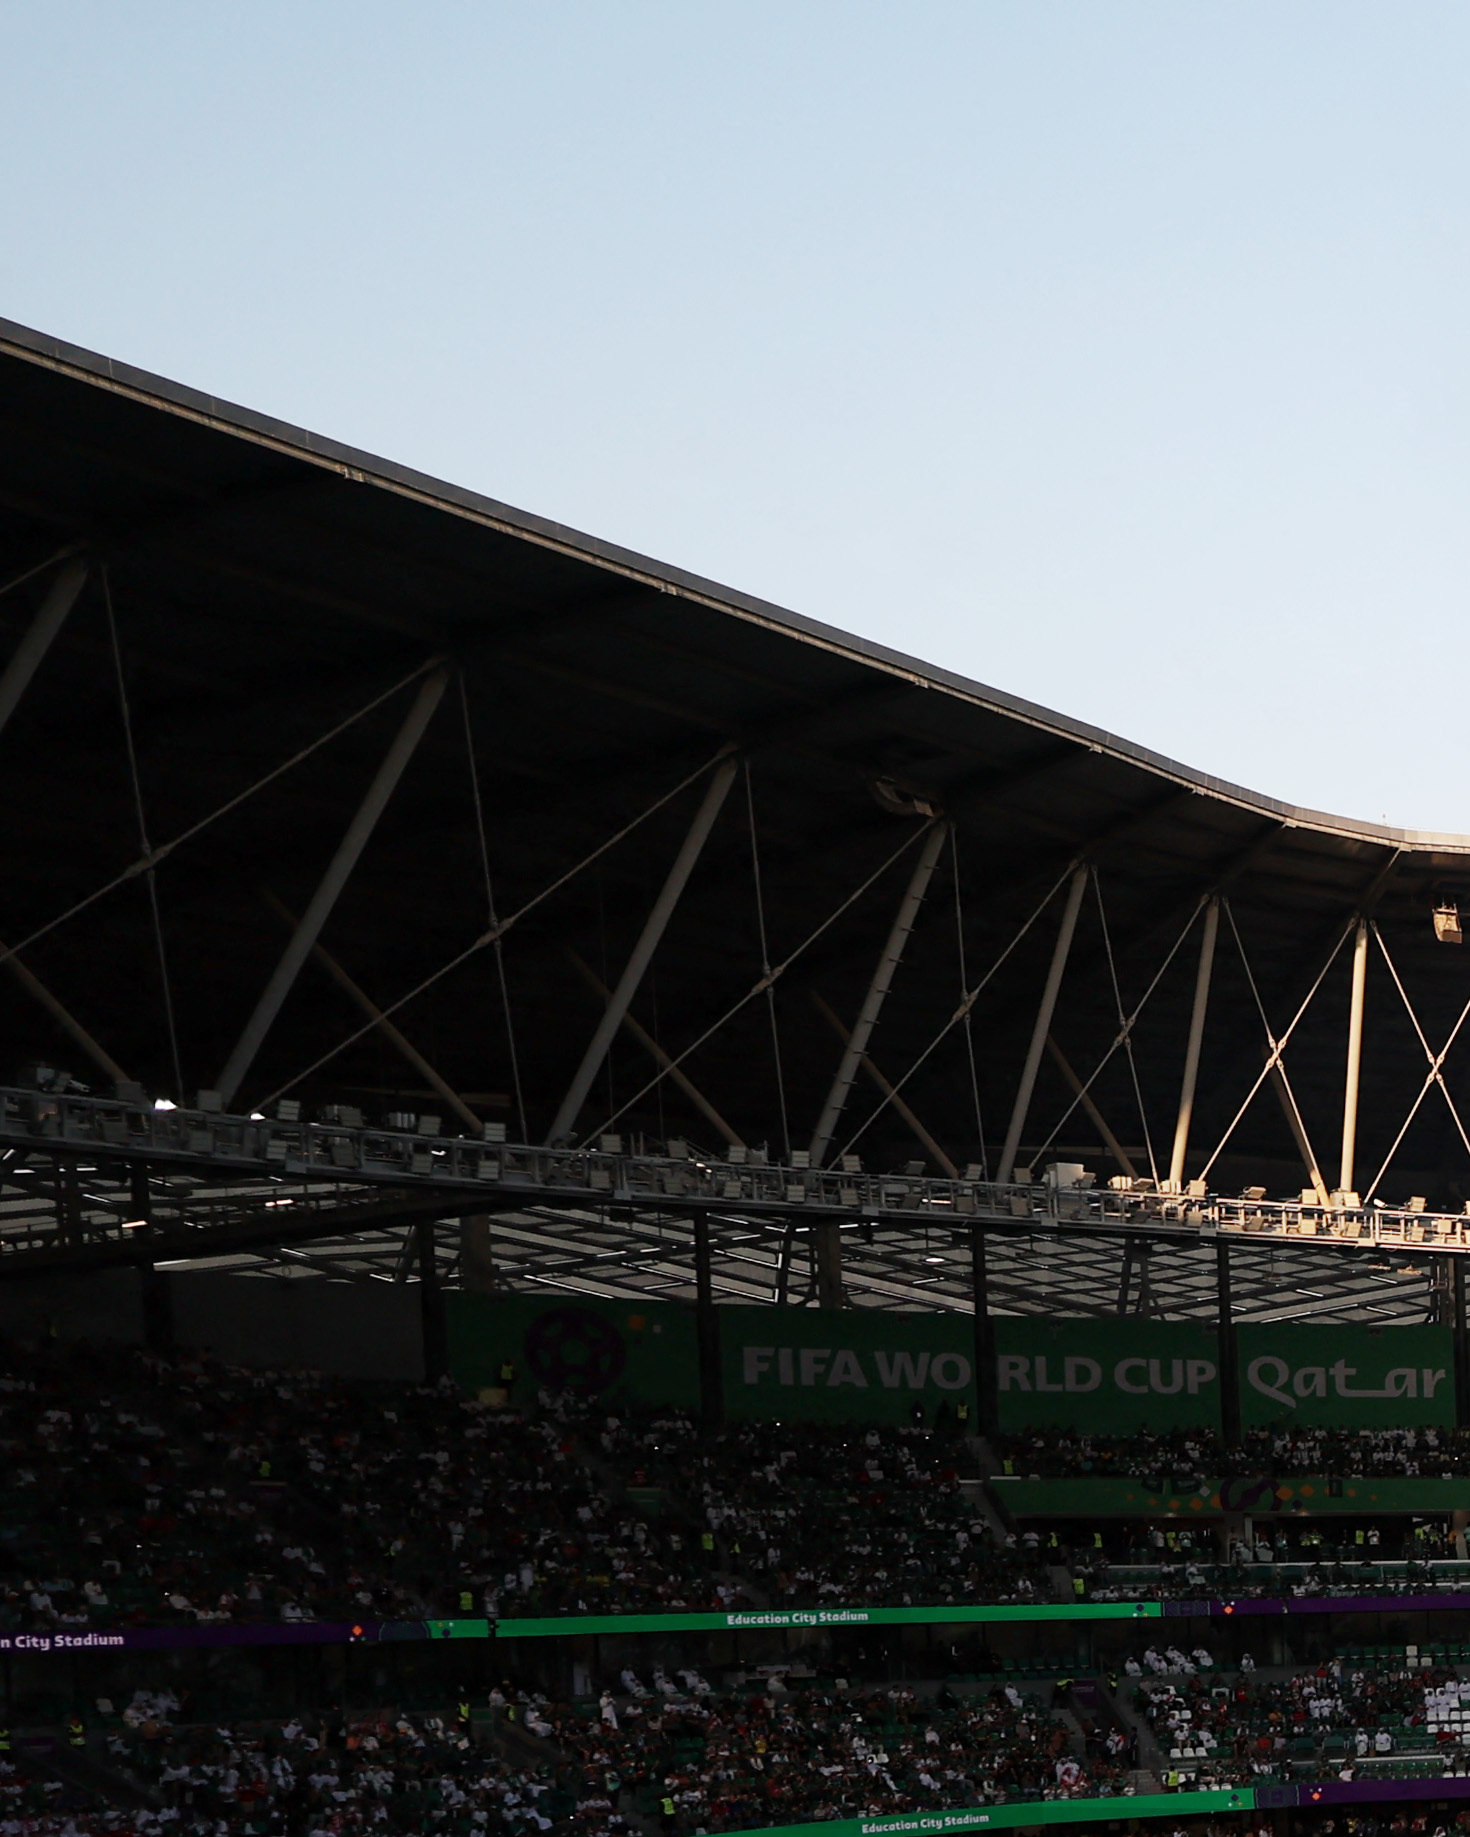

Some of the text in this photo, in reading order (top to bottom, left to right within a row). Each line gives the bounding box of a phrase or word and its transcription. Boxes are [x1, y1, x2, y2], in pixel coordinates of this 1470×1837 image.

[742, 1346, 1217, 1395] FIFA WORLD CUP
[1247, 1355, 1447, 1409] Qatar
[727, 1611, 869, 1625] Education City Stadium
[15, 1636, 51, 1652] City
[54, 1633, 125, 1649] Stadium
[861, 1814, 990, 1835] Education City Stadium
